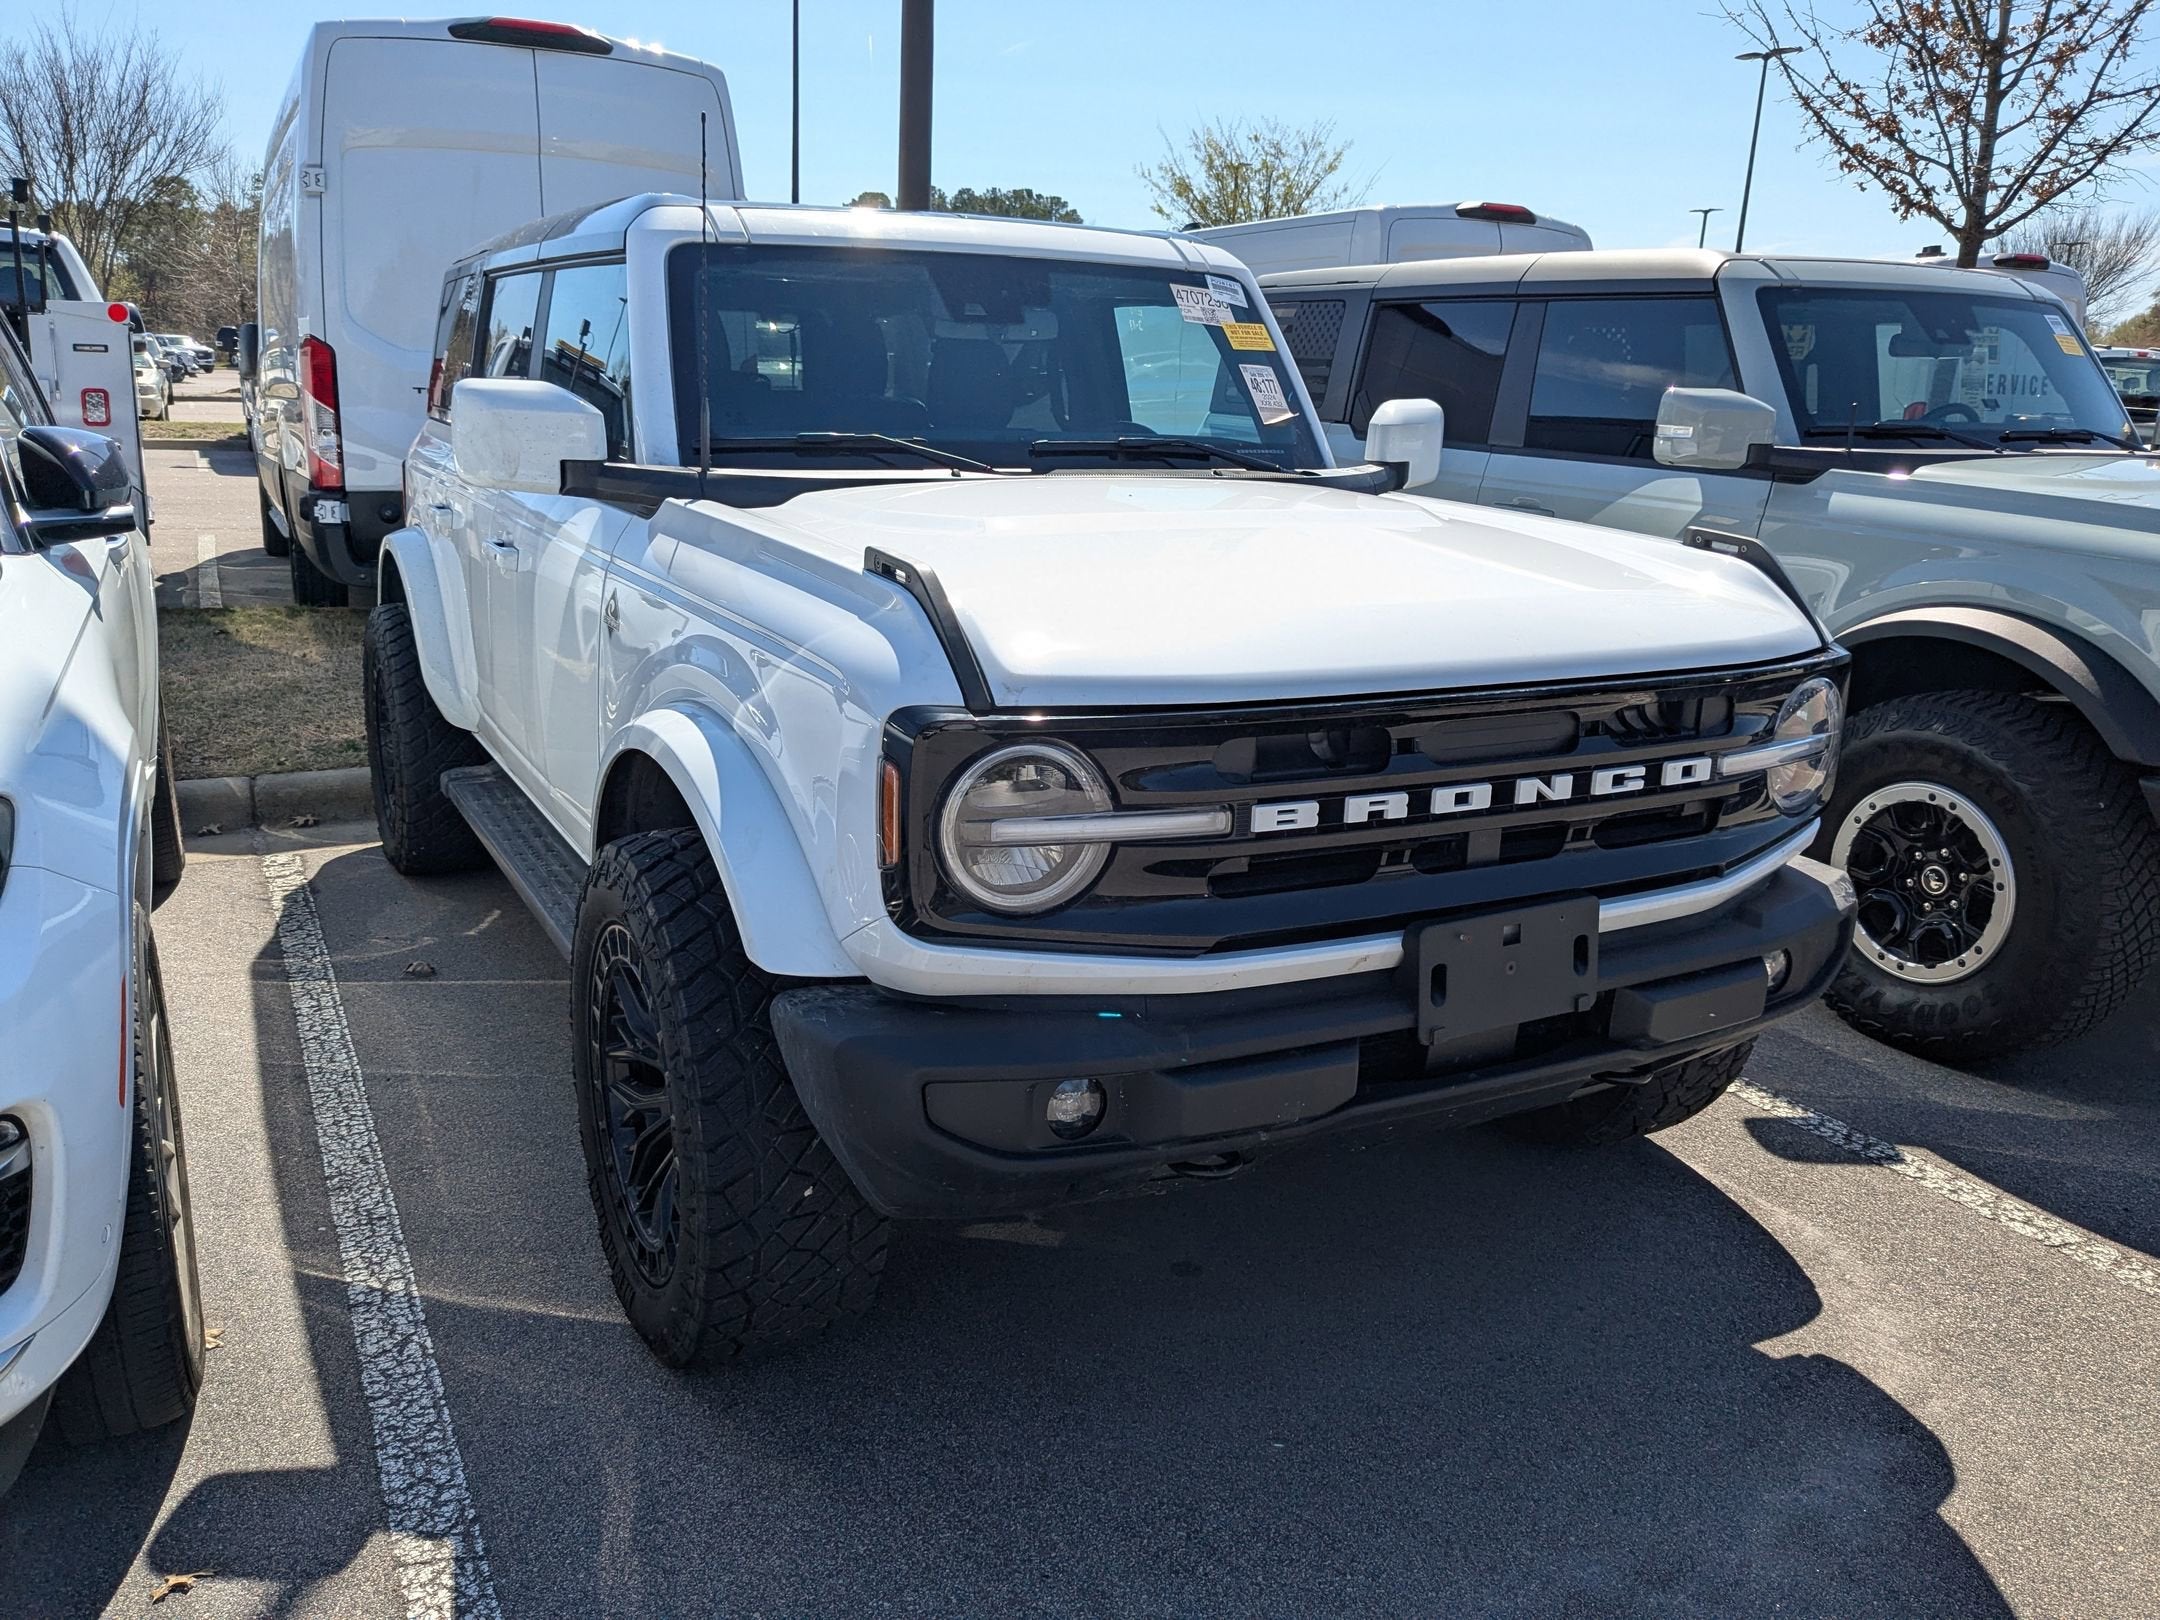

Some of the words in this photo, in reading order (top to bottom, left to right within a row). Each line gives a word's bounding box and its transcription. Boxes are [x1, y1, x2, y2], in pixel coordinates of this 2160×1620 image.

[1250, 377, 1278, 395] 48:177
[1987, 373, 2048, 396] ERVICE
[1251, 757, 1712, 833] BRONCO
